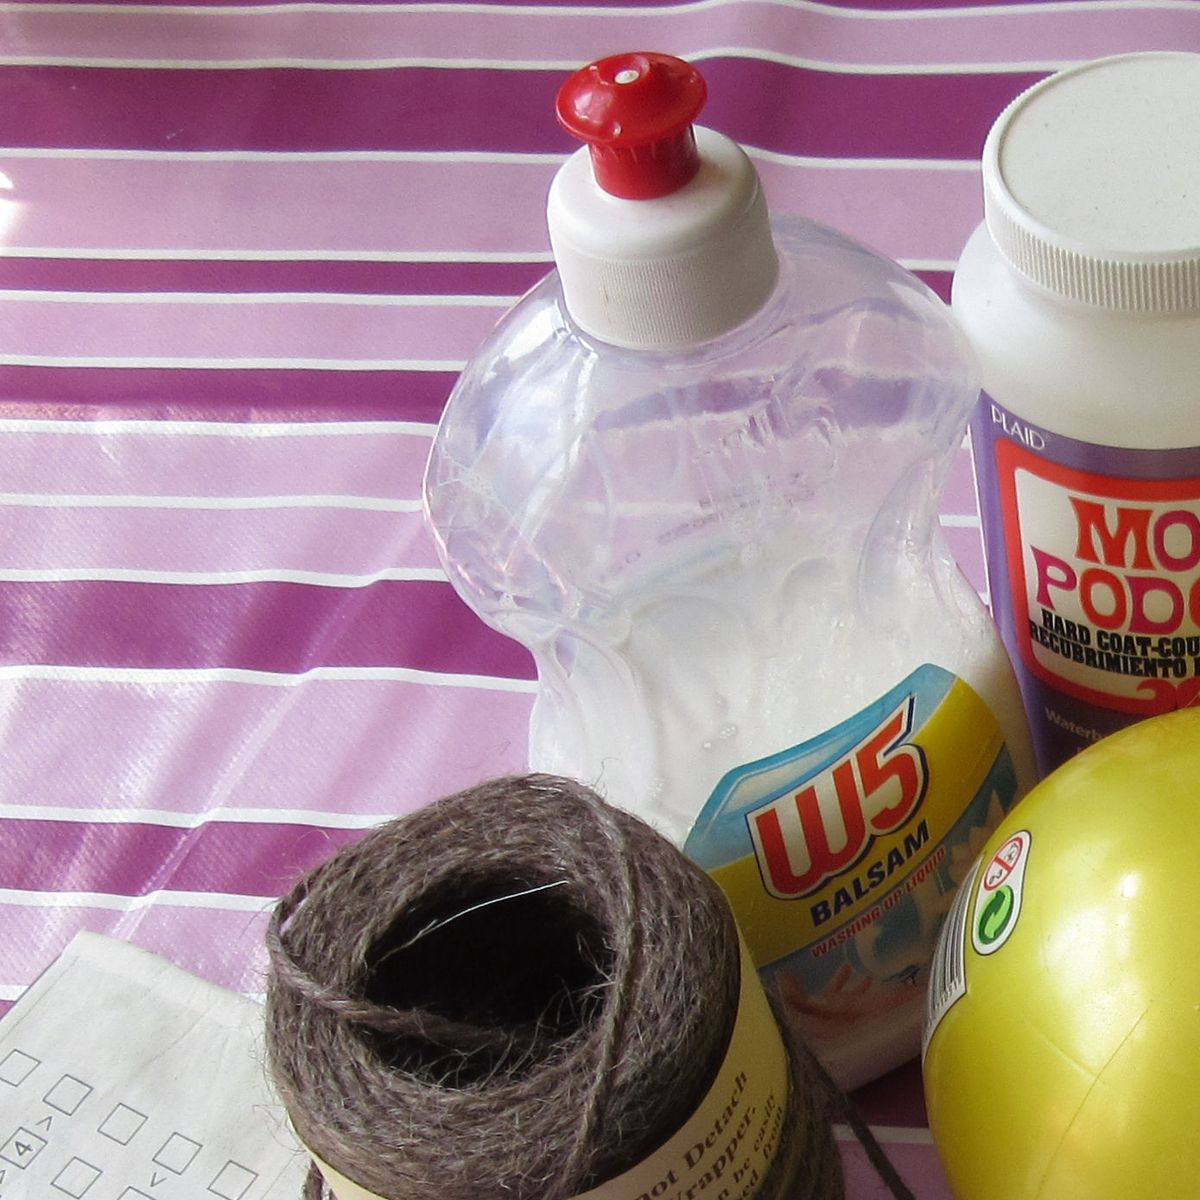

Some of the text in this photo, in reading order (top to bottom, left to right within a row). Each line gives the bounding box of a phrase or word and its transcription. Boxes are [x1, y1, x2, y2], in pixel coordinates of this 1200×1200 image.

[990, 404, 1046, 451] PLAID
[1030, 621, 1187, 678] RECUBRIMIENTO
[1041, 607, 1091, 646] HARD
[749, 700, 926, 898] W5
[809, 818, 930, 928] BALSAM
[810, 902, 881, 958] WASHING
[903, 845, 946, 894] LIQUID
[15, 1141, 32, 1156] 4
[683, 1072, 747, 1170] Detach
[733, 1158, 750, 1183] be
